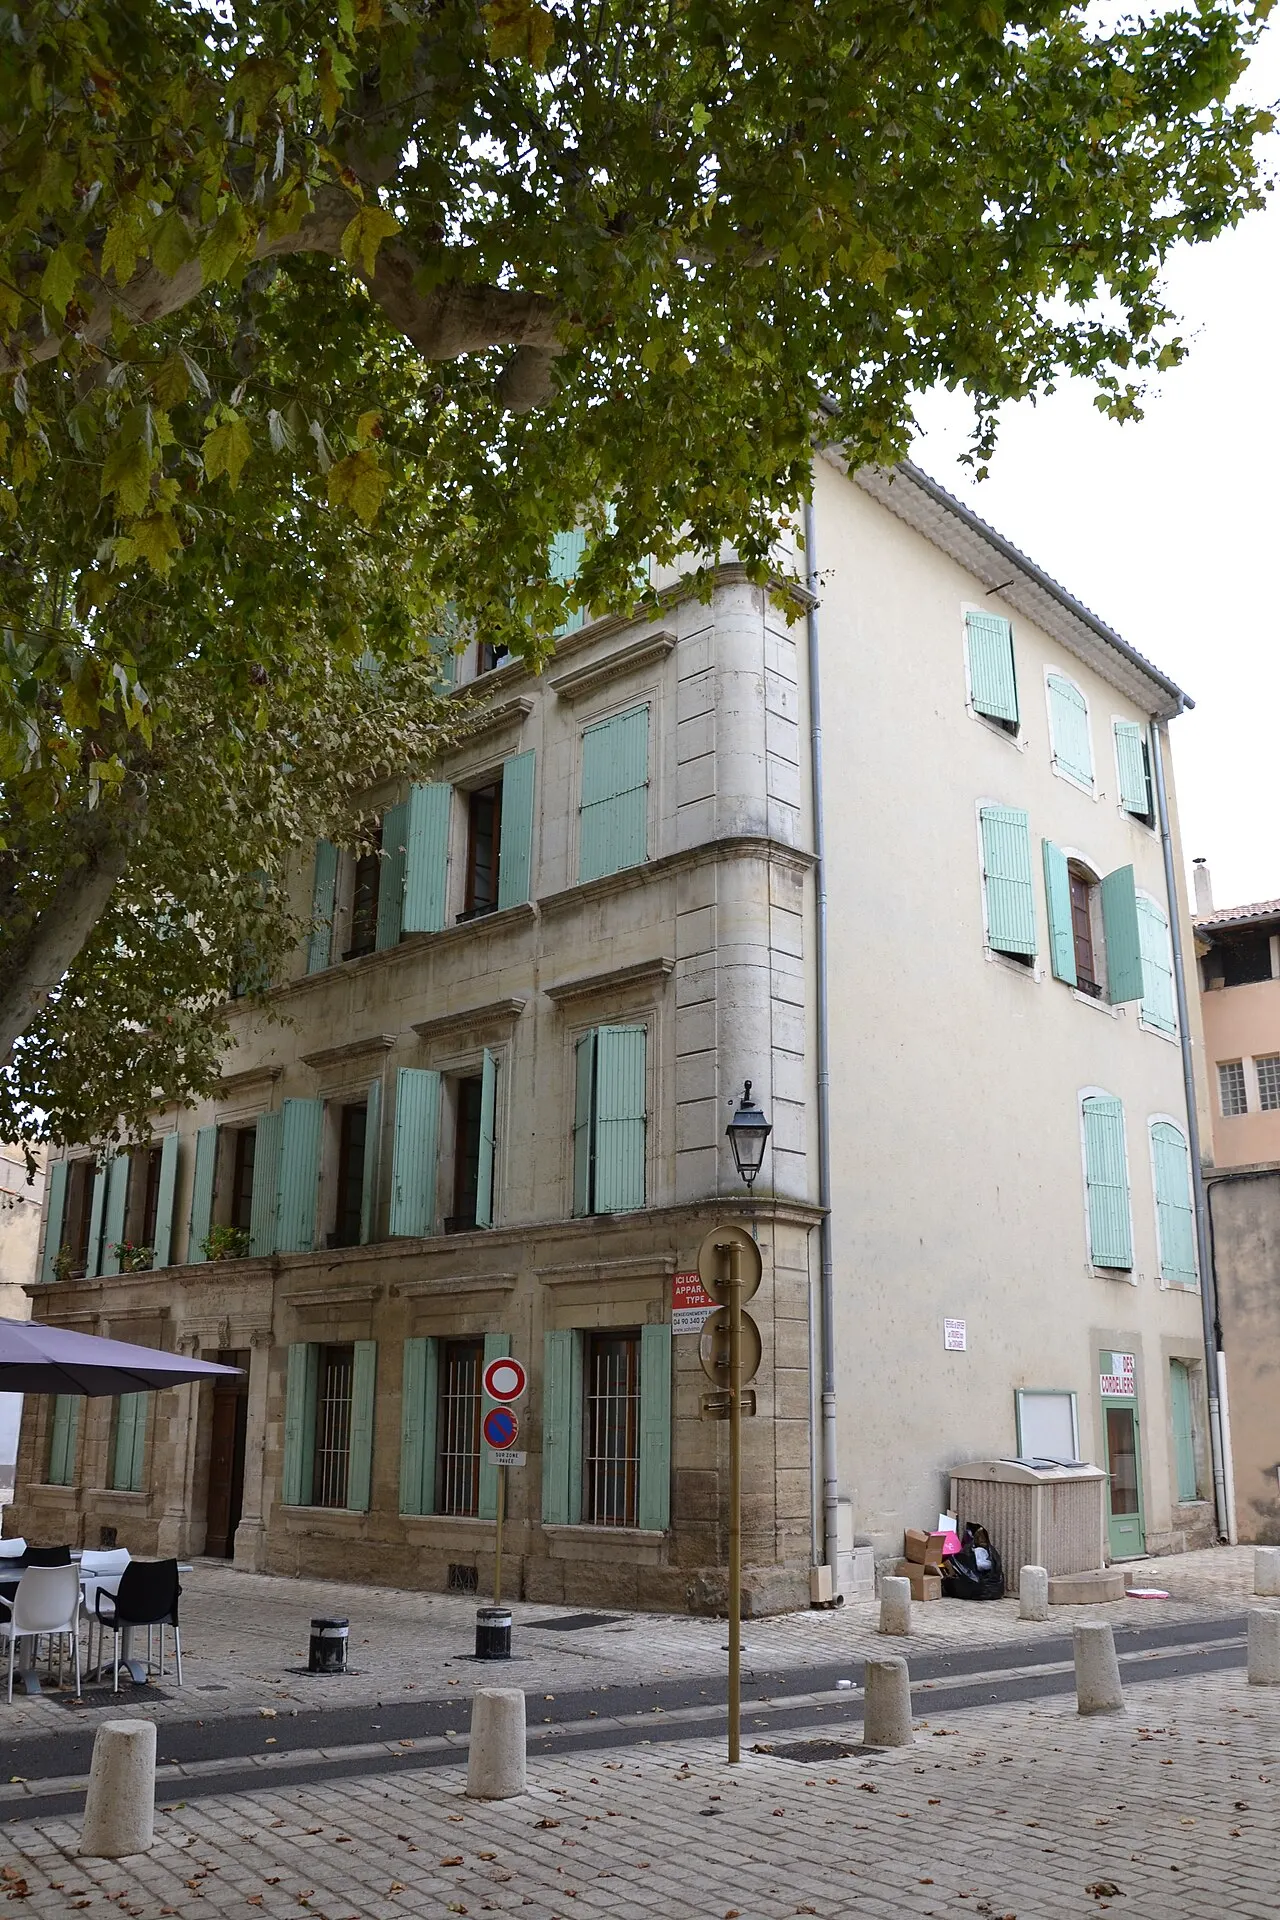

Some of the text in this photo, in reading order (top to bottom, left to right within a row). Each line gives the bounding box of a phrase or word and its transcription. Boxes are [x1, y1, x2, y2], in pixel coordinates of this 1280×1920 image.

[675, 1286, 705, 1295] APPAR
[686, 1295, 705, 1304] TYPE
[1122, 1355, 1133, 1373] DES
[1101, 1375, 1134, 1394] CORDELIERS
